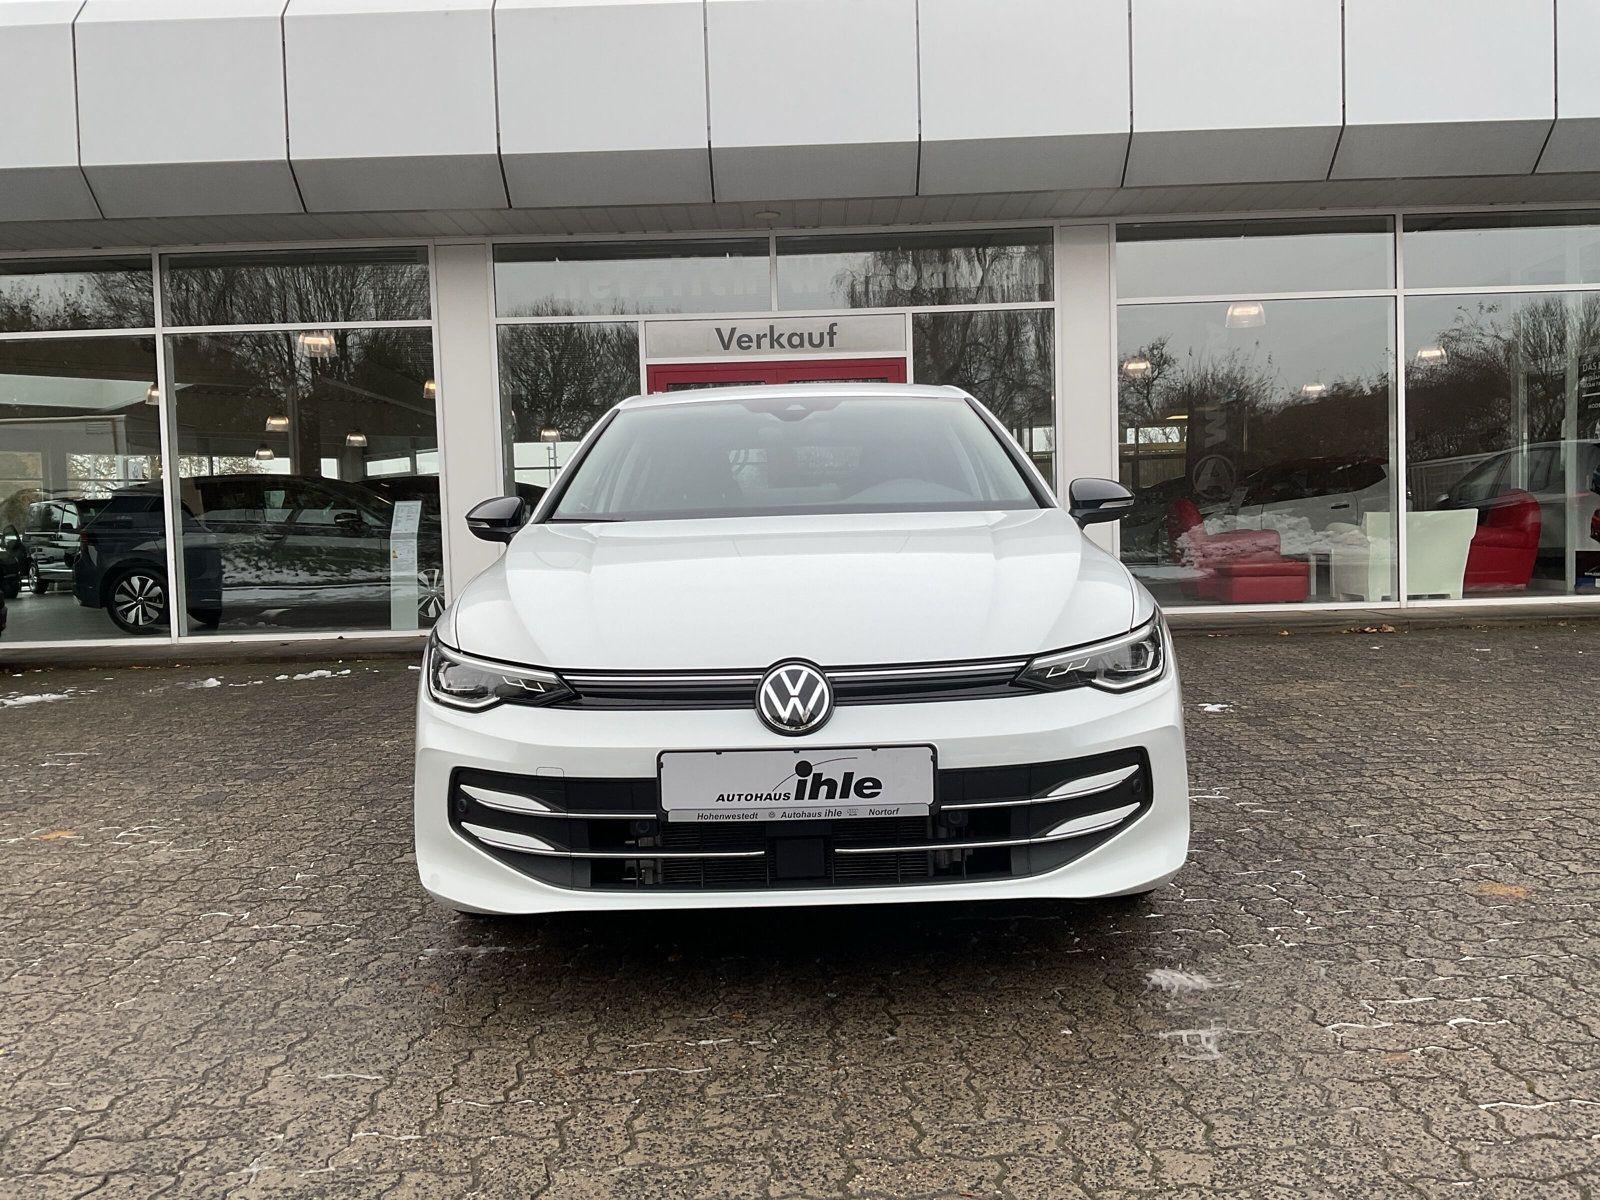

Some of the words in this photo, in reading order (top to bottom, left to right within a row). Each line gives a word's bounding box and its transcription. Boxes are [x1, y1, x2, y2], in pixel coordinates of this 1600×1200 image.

[714, 323, 838, 351] Verkauf
[715, 792, 791, 803] AUTOHAUS
[794, 760, 883, 801] ihle
[697, 811, 758, 820] Hohenwestedt
[780, 810, 822, 819] Autohaus
[824, 809, 842, 817] ihle
[868, 807, 900, 816] Nortorf
